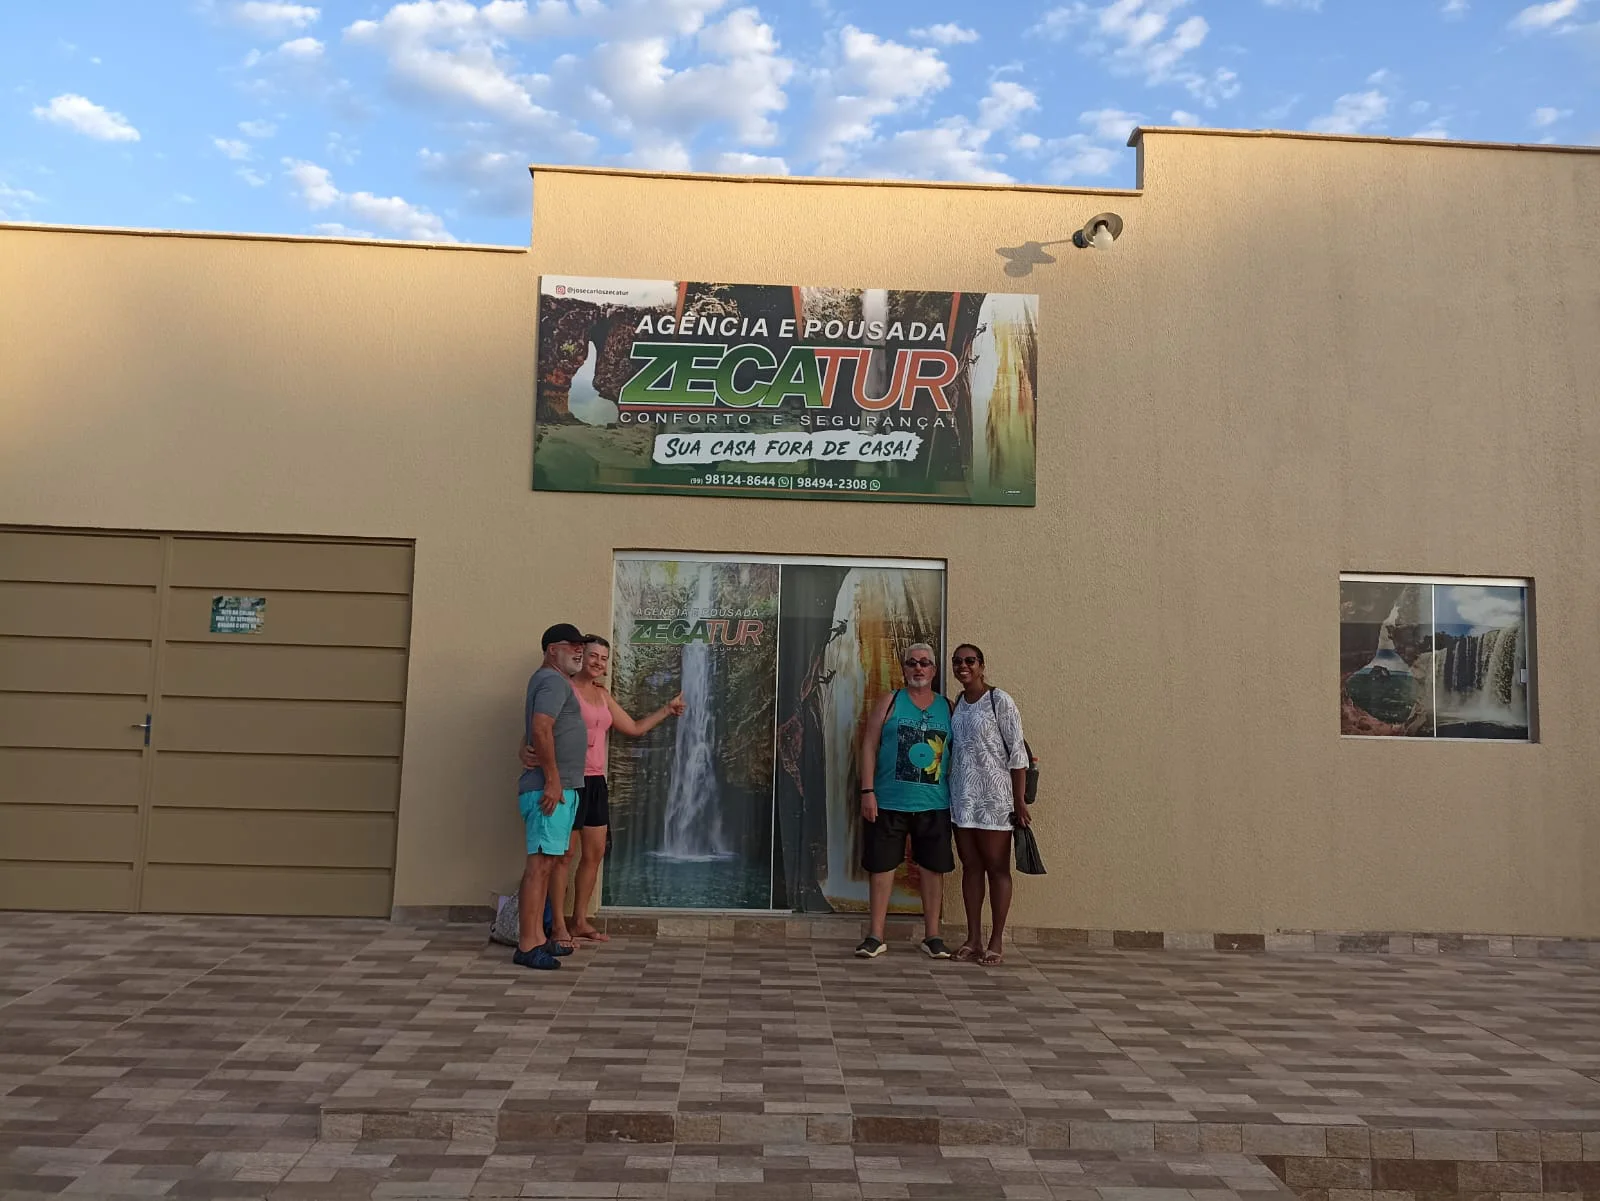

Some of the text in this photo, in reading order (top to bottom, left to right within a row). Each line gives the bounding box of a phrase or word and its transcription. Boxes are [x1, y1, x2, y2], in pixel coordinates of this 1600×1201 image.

[567, 286, 629, 296] @josecarloszecatur
[635, 311, 947, 342] AGÊNCIA E POUSADA
[618, 341, 959, 412] ZECATUR
[619, 412, 956, 429] CONFORTO E SEGURANÇA!
[665, 437, 913, 458] SUA CASA FORA DE CASA!
[705, 474, 776, 487] 98124-8644
[797, 477, 868, 490] 98494-2308
[701, 608, 759, 617] POUSADA
[630, 618, 764, 646] ZECATUR
